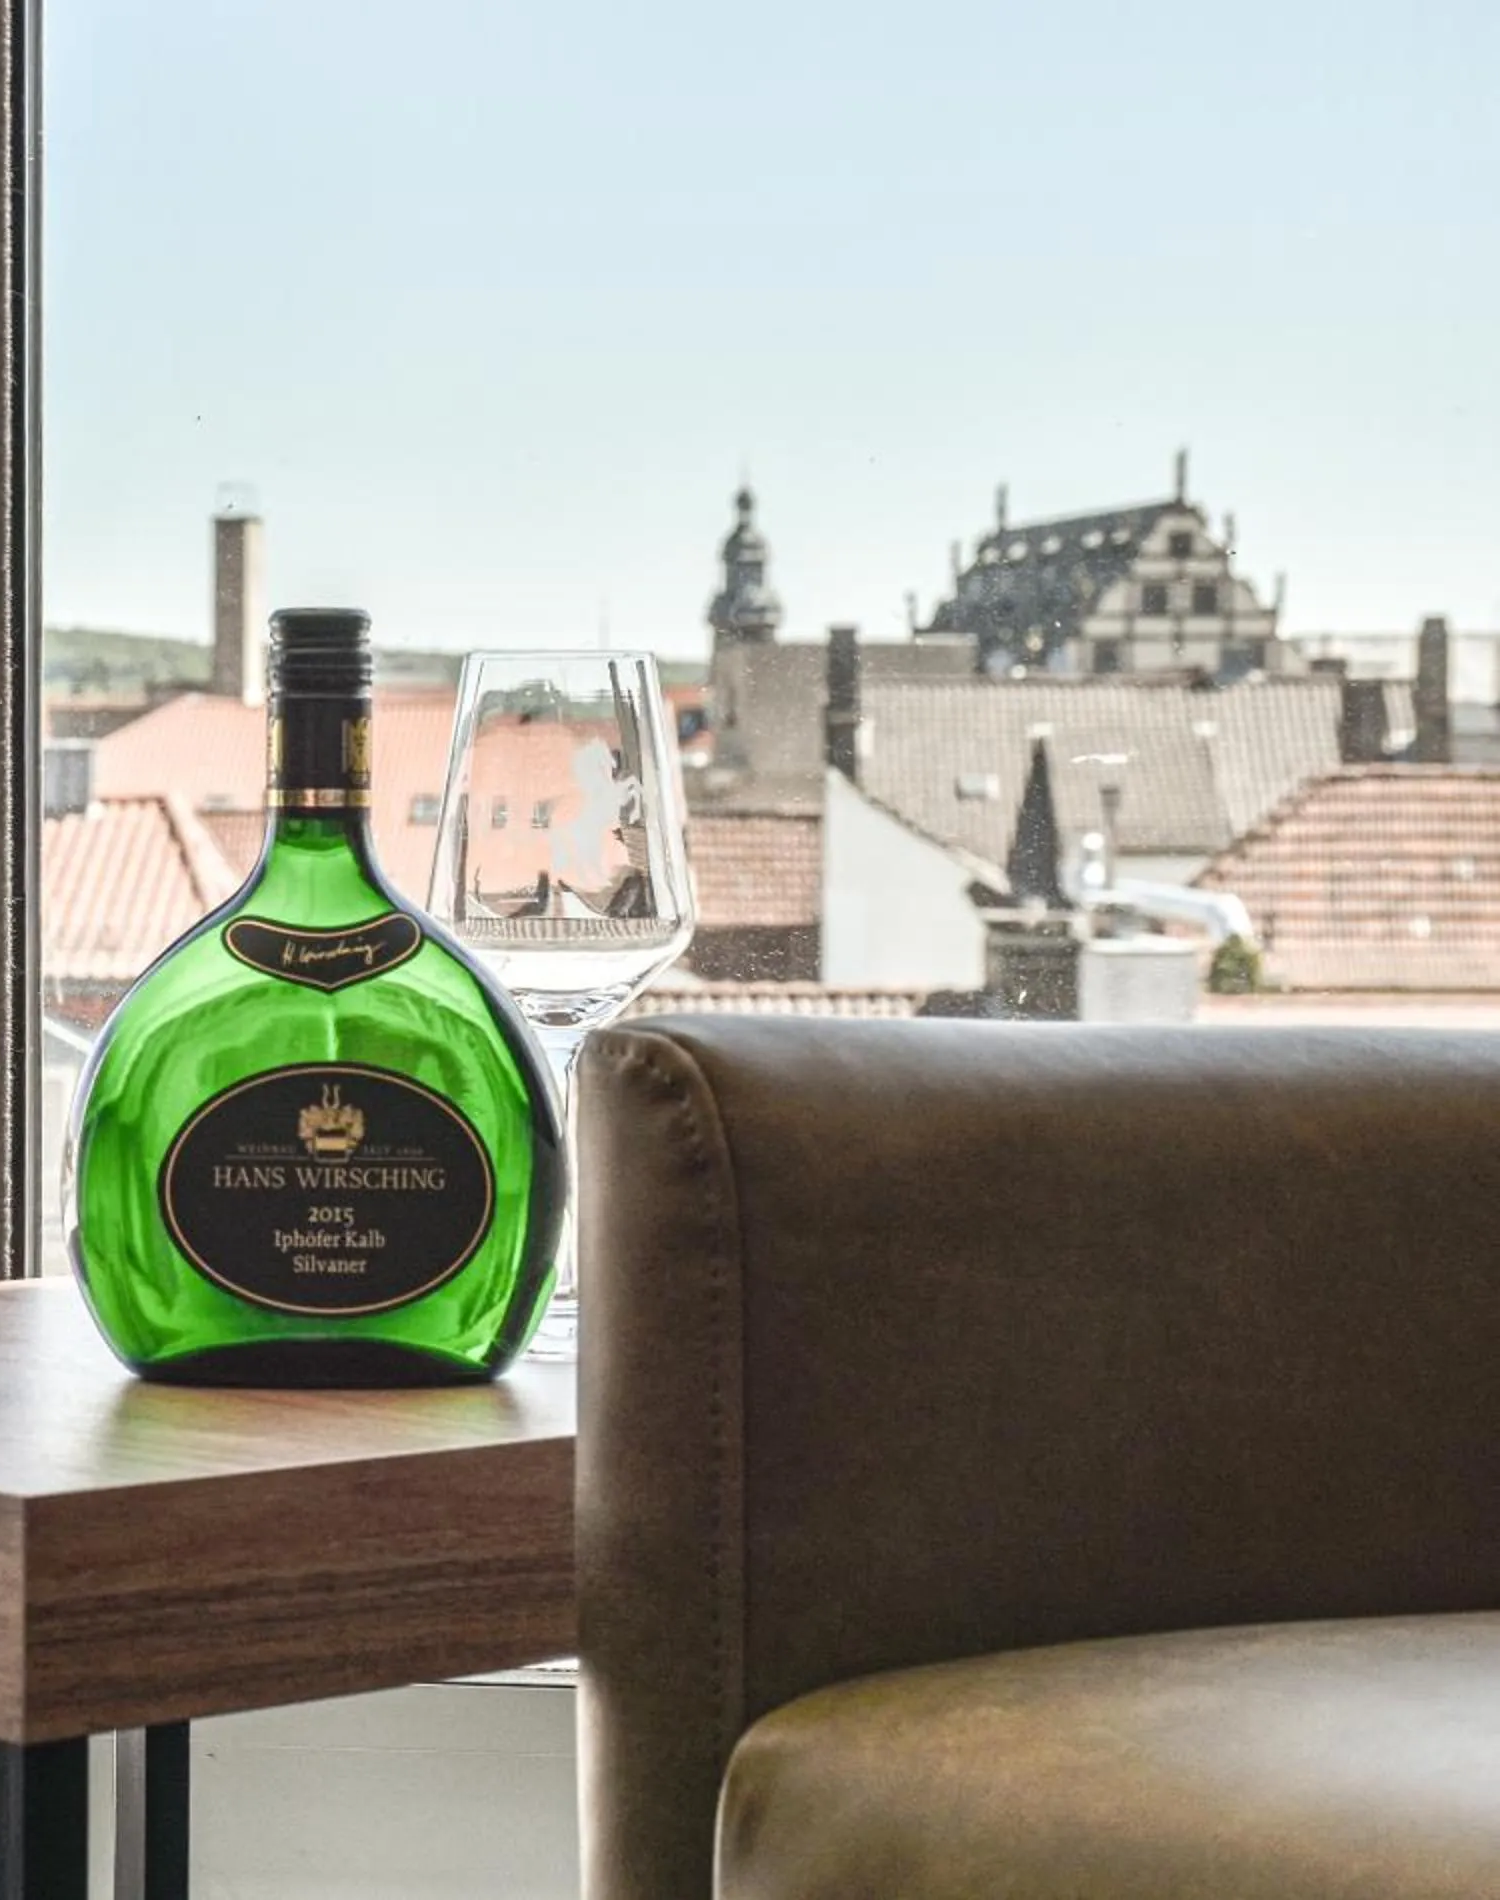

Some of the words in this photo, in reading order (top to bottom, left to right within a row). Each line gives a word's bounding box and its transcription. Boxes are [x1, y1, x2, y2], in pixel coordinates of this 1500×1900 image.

[214, 1165, 286, 1190] HANS
[296, 1165, 446, 1190] WIRSCHING
[308, 1206, 355, 1228] 2015
[345, 1228, 386, 1249] Kalb
[293, 1254, 367, 1274] Silvaner
